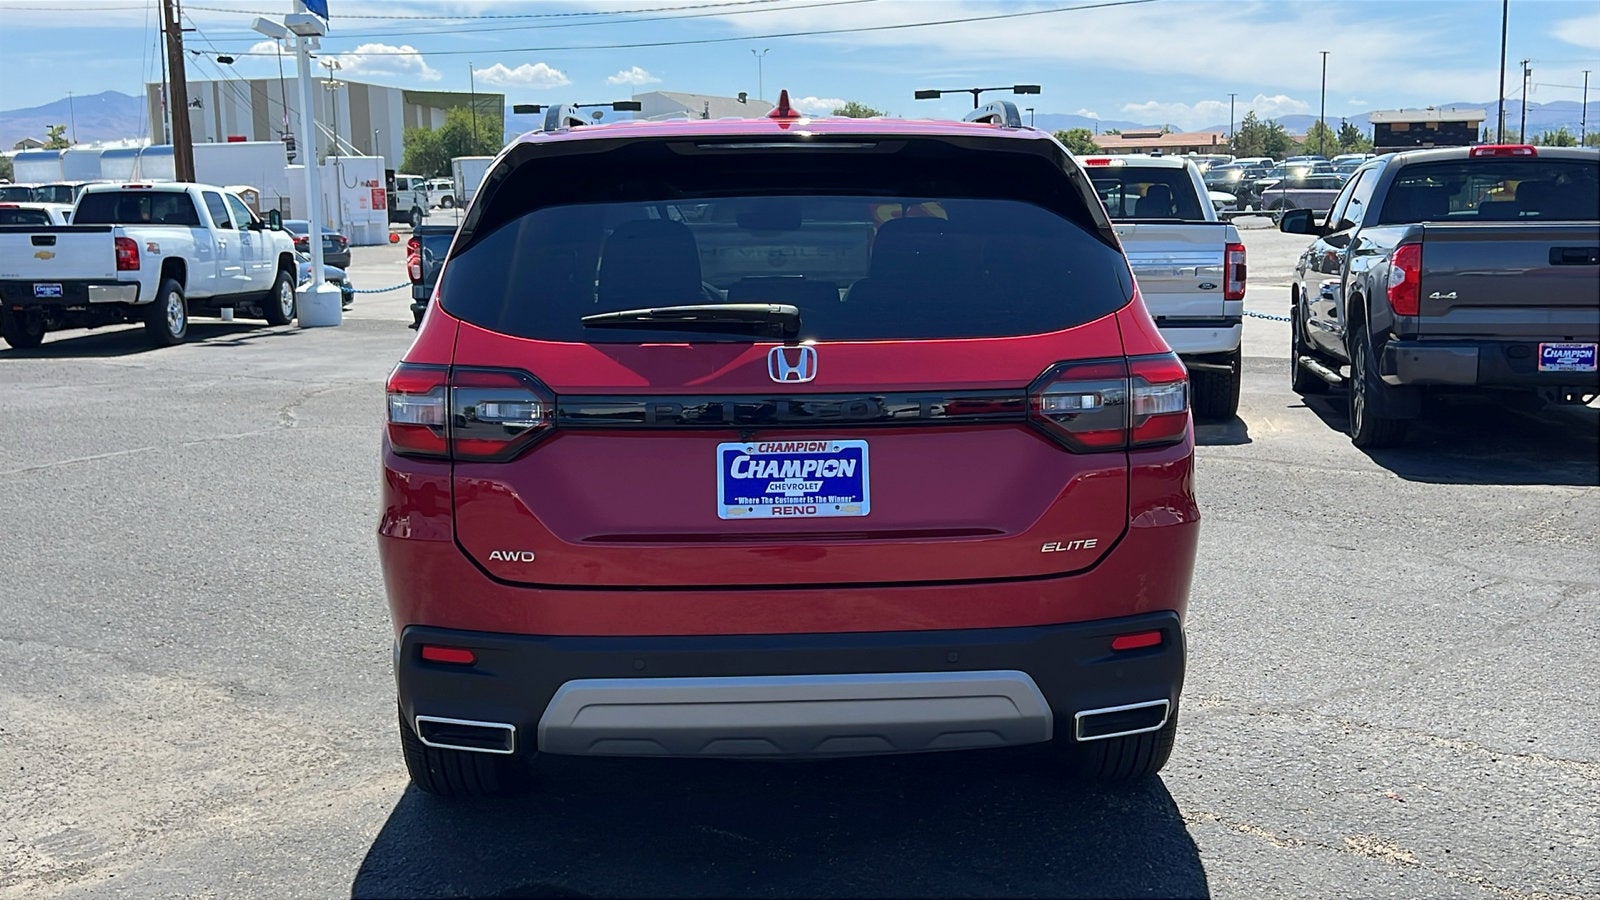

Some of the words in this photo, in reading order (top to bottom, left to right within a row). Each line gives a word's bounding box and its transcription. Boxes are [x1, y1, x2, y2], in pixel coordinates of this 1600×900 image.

[1543, 348, 1593, 358] CHAMPION
[758, 442, 828, 453] CHAMPION
[730, 455, 857, 479] CHAMPION
[769, 482, 819, 491] CHEVROLET
[761, 496, 774, 504] The
[774, 496, 806, 504] Customer
[815, 495, 827, 503] The
[771, 505, 817, 515] RENO
[1041, 538, 1098, 553] ELITE
[488, 550, 535, 562] AWD
